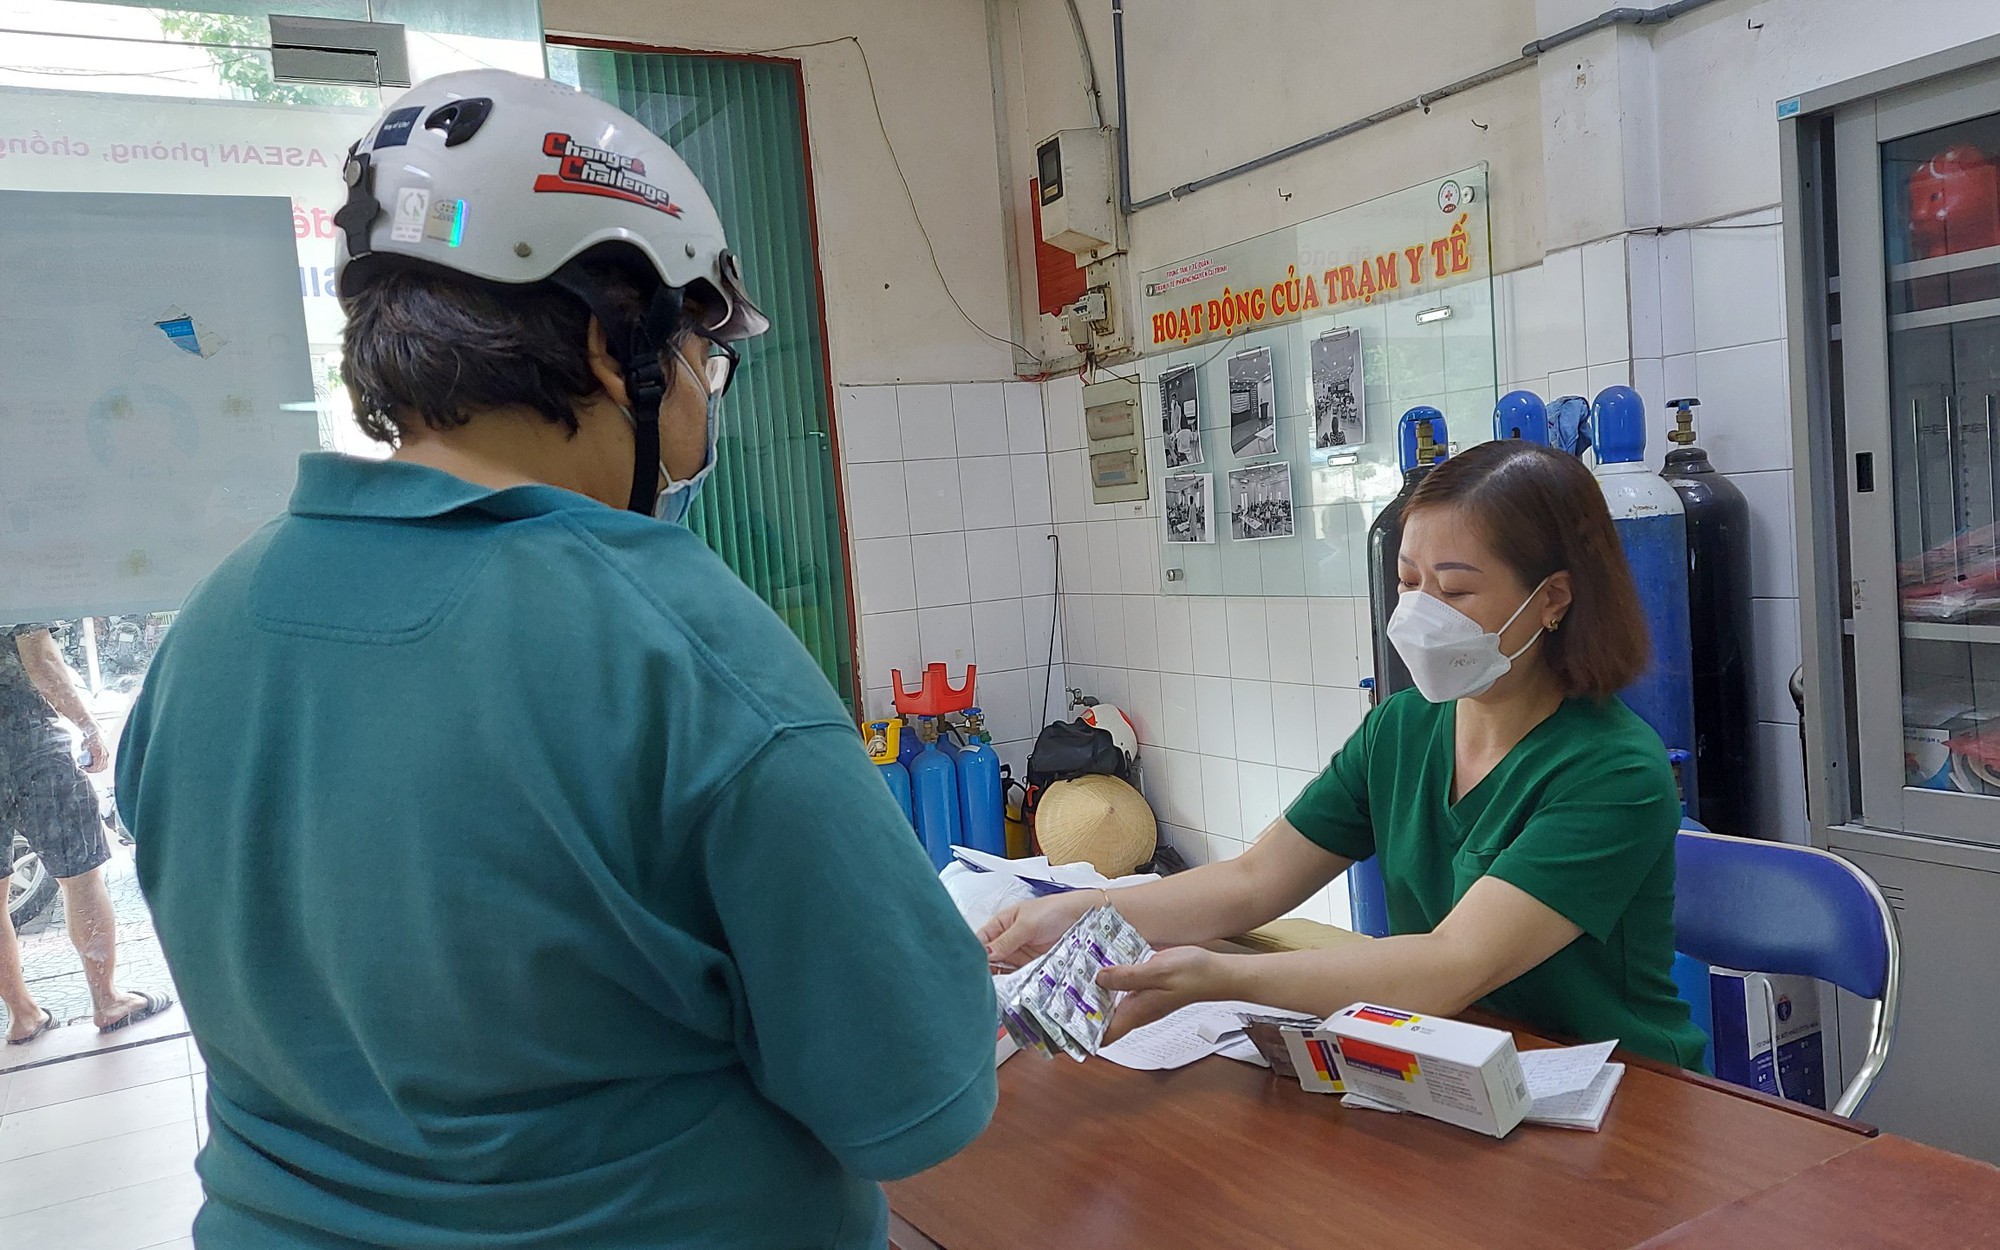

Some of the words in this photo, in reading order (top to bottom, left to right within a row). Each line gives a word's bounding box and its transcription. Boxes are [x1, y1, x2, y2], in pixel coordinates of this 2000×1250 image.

[560, 156, 669, 206] Challenge
[1152, 303, 1203, 344] HOẠT
[1208, 287, 1266, 336] ĐỘNG
[1271, 264, 1320, 317] CỦA
[1324, 252, 1398, 304] TRẠM
[1404, 244, 1424, 285] Y
[1431, 212, 1472, 279] TẾ
